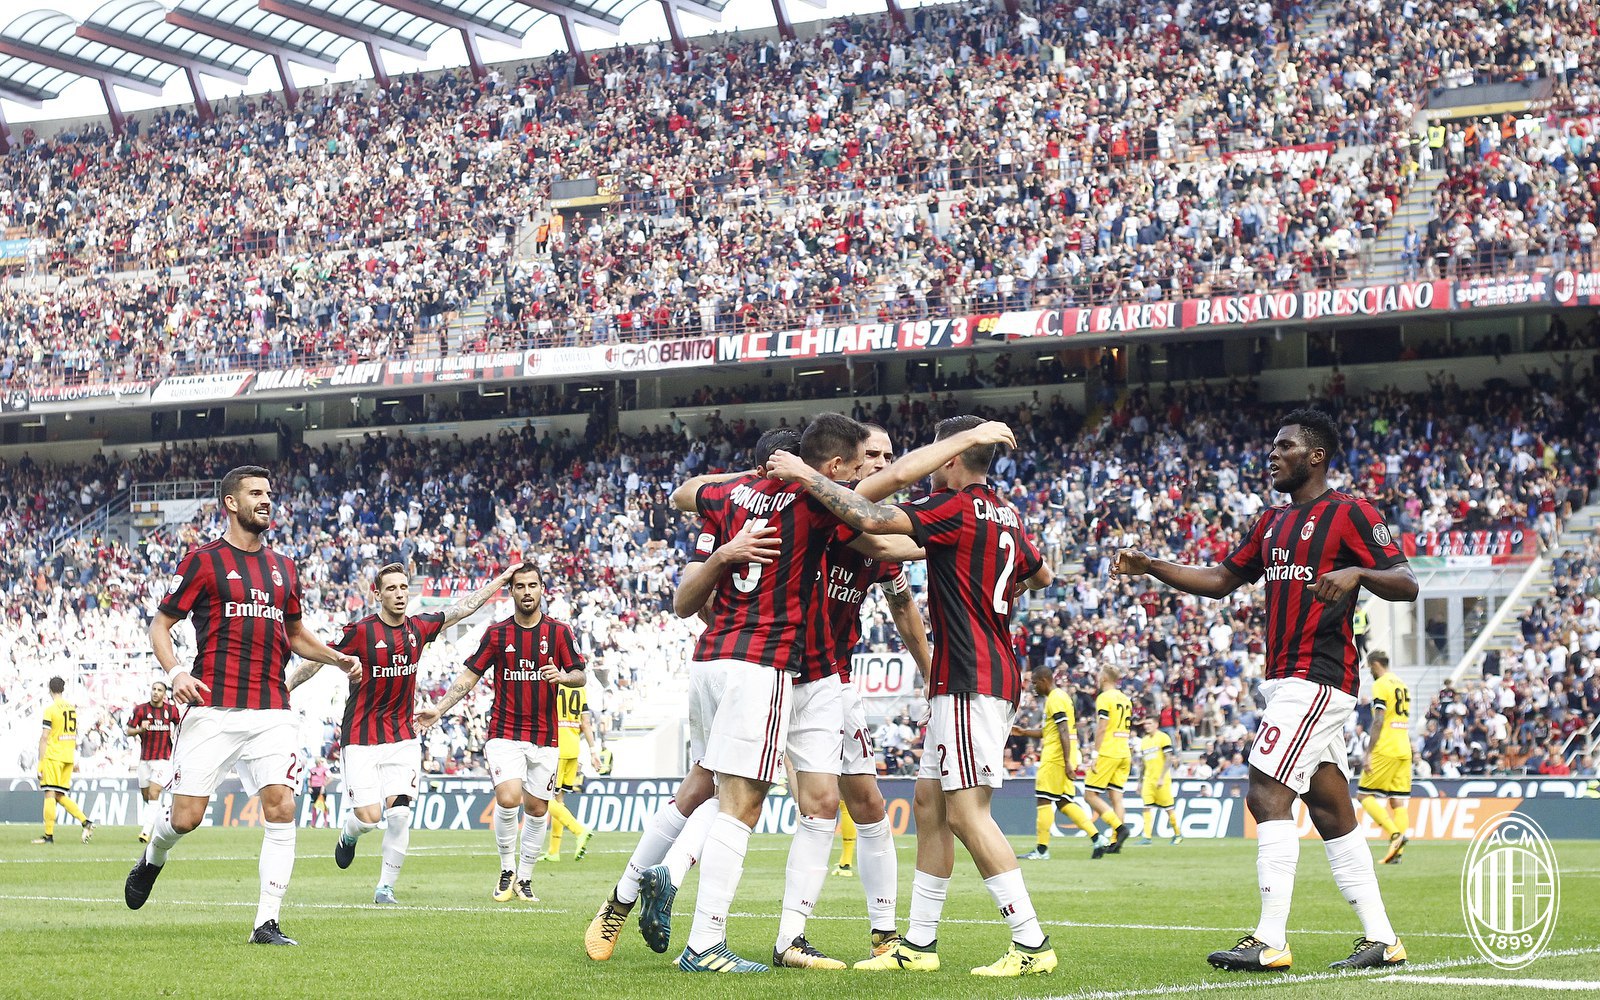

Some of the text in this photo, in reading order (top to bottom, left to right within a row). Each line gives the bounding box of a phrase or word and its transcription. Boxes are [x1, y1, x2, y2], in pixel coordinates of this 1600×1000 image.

[1456, 282, 1546, 302] SUPERSTAR
[1096, 302, 1176, 331] BARESI
[1196, 292, 1297, 324] BASSANO
[1303, 282, 1433, 319] BRESCIANO
[901, 317, 968, 347] 1973
[660, 339, 712, 363] BENITO
[388, 360, 413, 374] MILAN
[413, 359, 434, 372] CLUB
[442, 355, 475, 370] MALDINI
[165, 374, 243, 386] MILAN CLUB
[254, 368, 305, 391] MILAN
[330, 363, 382, 385] CARPI
[1415, 530, 1523, 547] GIANNINO
[1272, 547, 1289, 562] Fly
[1433, 544, 1506, 556] BRUNETTI
[830, 565, 853, 584] Fly
[993, 531, 1015, 616] 2
[1265, 562, 1313, 582] mirates
[250, 588, 269, 603] Fly
[225, 601, 284, 623] Emirates
[372, 662, 418, 678] Emirate
[392, 654, 408, 667] Fly
[519, 659, 535, 669] Fly
[503, 667, 547, 681] Emirat
[558, 688, 580, 720] 14
[1395, 687, 1411, 717] 85
[62, 710, 77, 733] 15
[854, 727, 874, 759] 19
[1251, 721, 1281, 755] 79
[938, 744, 949, 776] 2
[223, 793, 265, 828] 1.4
[450, 795, 477, 831] X
[577, 795, 672, 833] UDIN
[629, 862, 642, 874] MIL
[801, 900, 816, 909] MIL
[711, 915, 724, 923] MIL
